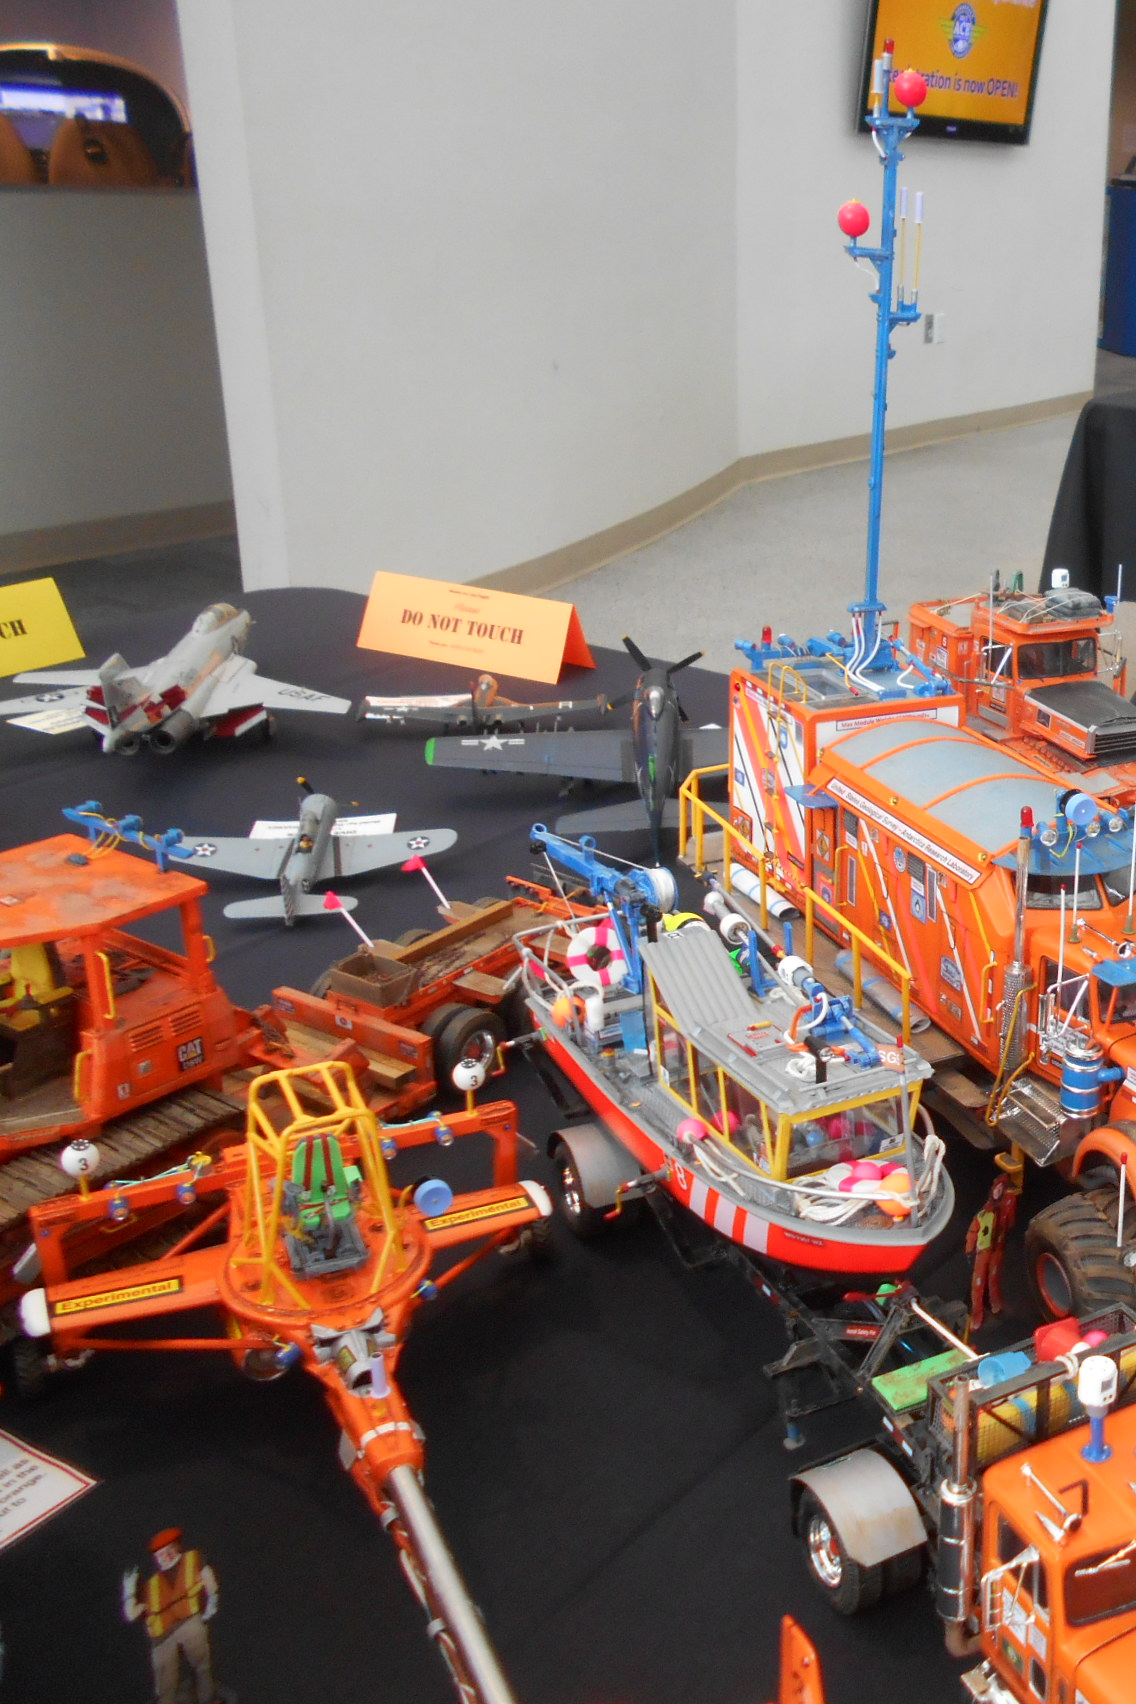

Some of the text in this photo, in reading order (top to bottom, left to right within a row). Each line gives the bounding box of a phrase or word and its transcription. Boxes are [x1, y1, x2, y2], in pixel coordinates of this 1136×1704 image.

[963, 76, 986, 94] now
[987, 77, 1019, 98] OPEN!
[401, 608, 524, 645] DO NOT TOUCH
[882, 815, 898, 831] Survey
[925, 844, 948, 866] Research
[946, 857, 975, 881] Laboratory
[178, 1038, 202, 1062] CAT
[470, 1075, 478, 1087] 3
[78, 1158, 90, 1171] 3
[430, 1198, 522, 1228] Experimental
[61, 1281, 172, 1311] Experimental
